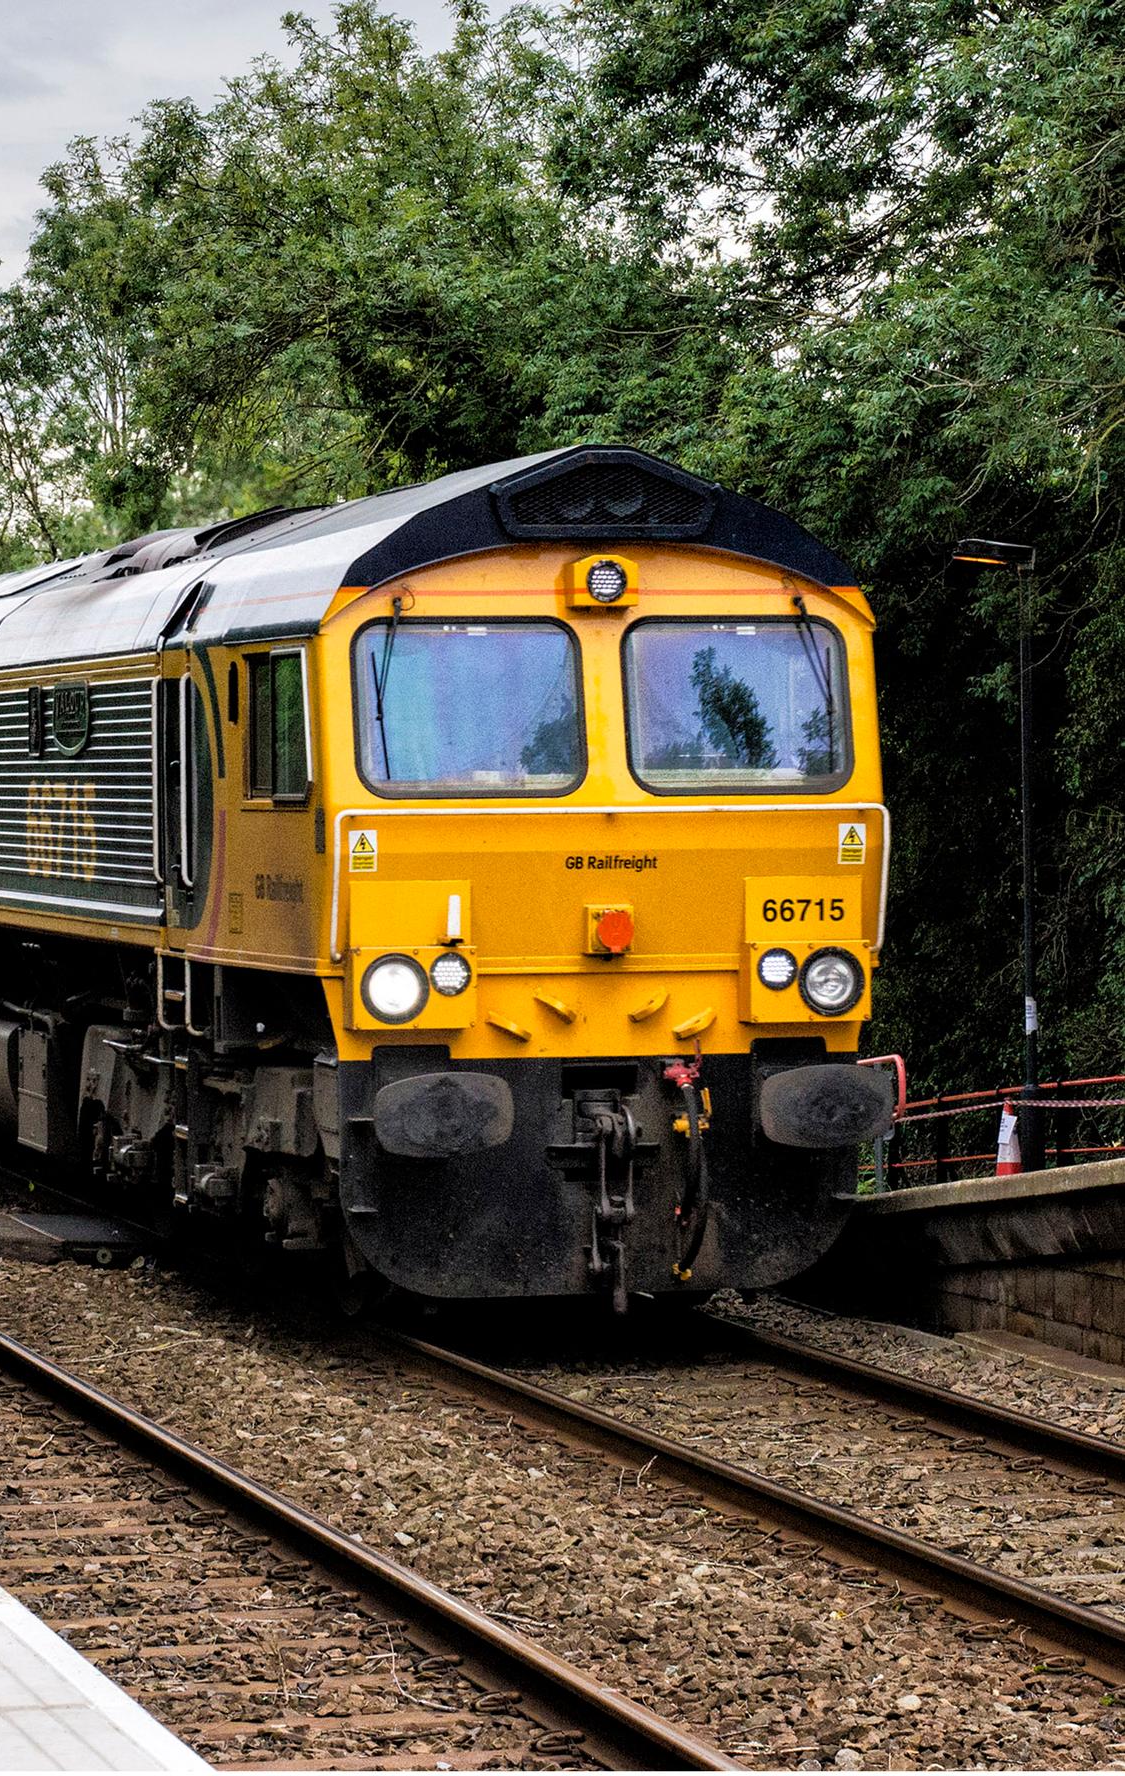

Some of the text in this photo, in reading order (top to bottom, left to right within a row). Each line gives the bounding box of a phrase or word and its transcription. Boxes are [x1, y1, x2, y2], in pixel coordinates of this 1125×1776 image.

[26, 780, 97, 881] 66715
[564, 855, 658, 872] GB Railfreight
[762, 898, 845, 922] 66715
